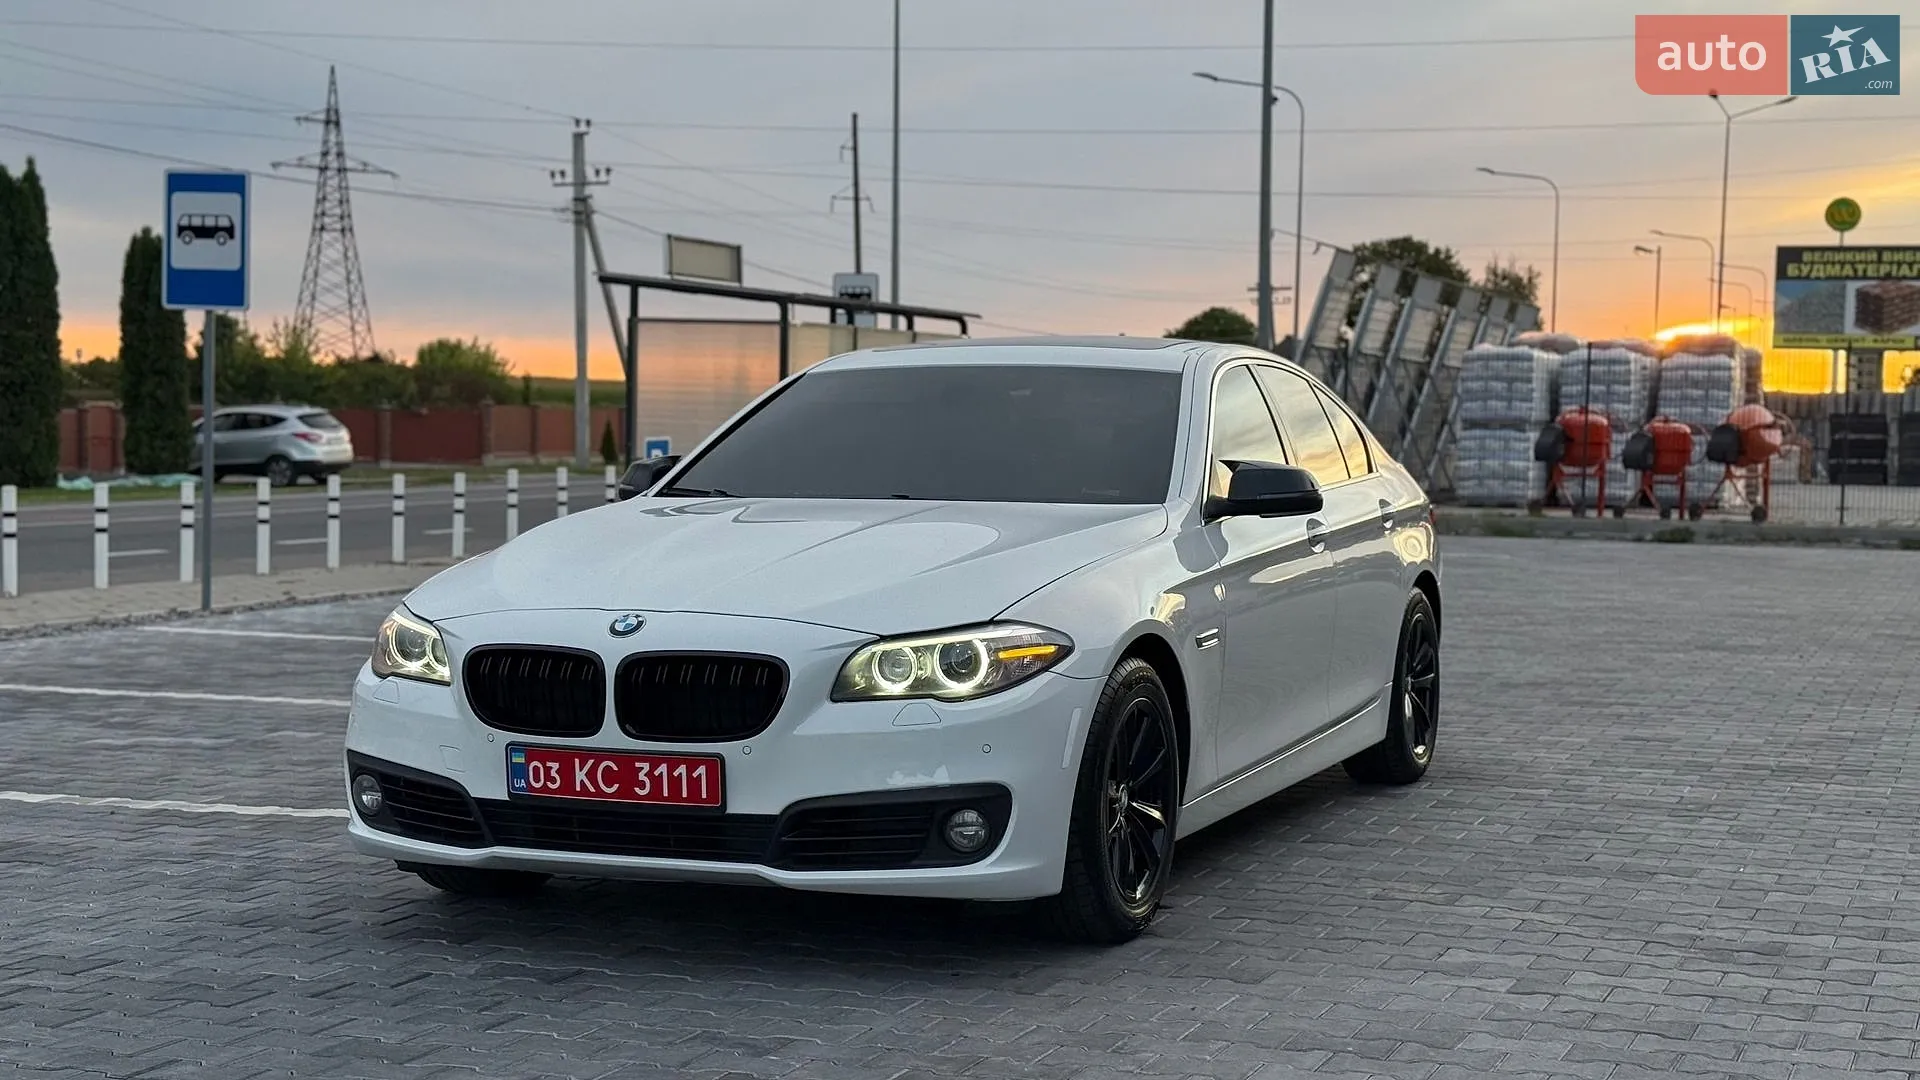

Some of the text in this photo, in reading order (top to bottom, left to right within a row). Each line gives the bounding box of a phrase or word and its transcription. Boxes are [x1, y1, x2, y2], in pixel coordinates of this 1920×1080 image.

[1802, 250, 1878, 262] ВЕЛИКИЙ
[514, 778, 526, 789] UA
[528, 758, 707, 799] 03 KC 3111
